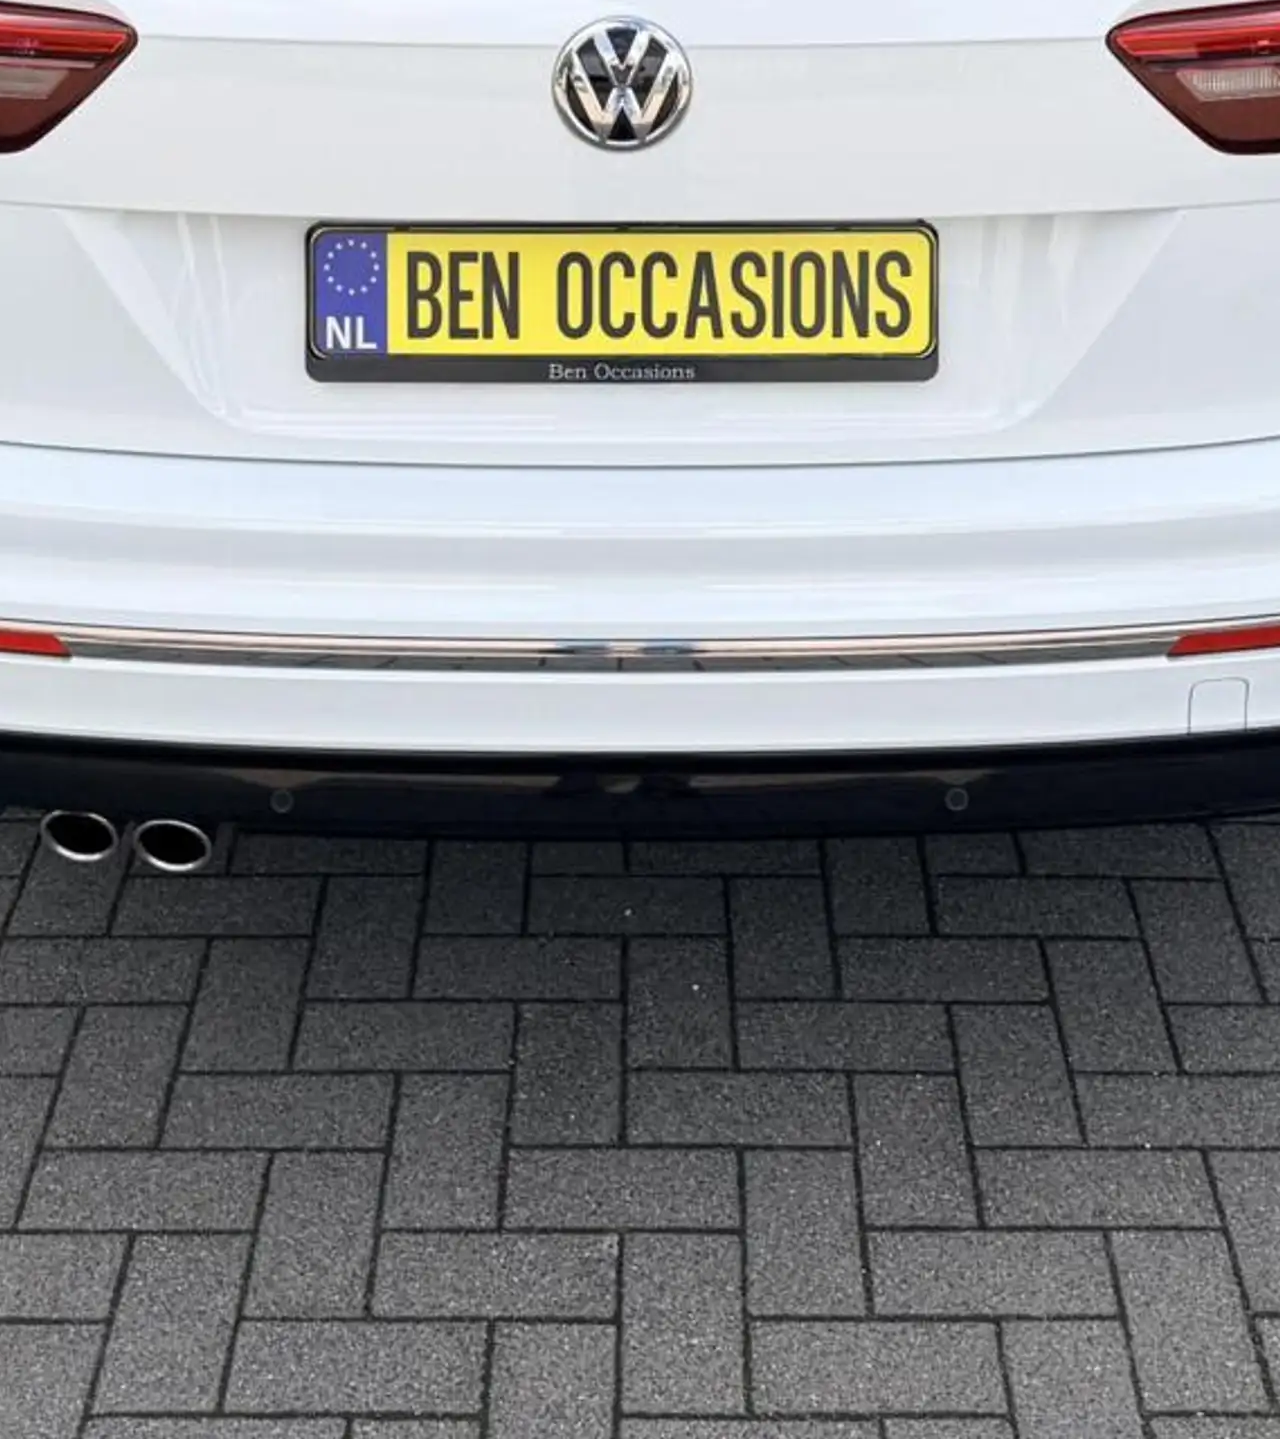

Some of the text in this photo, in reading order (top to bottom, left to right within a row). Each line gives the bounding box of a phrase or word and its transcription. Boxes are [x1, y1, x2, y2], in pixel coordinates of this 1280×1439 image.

[408, 250, 912, 339] BEN OCCASIONS
[324, 316, 378, 350] NL
[548, 363, 695, 380] Ben Occasions
